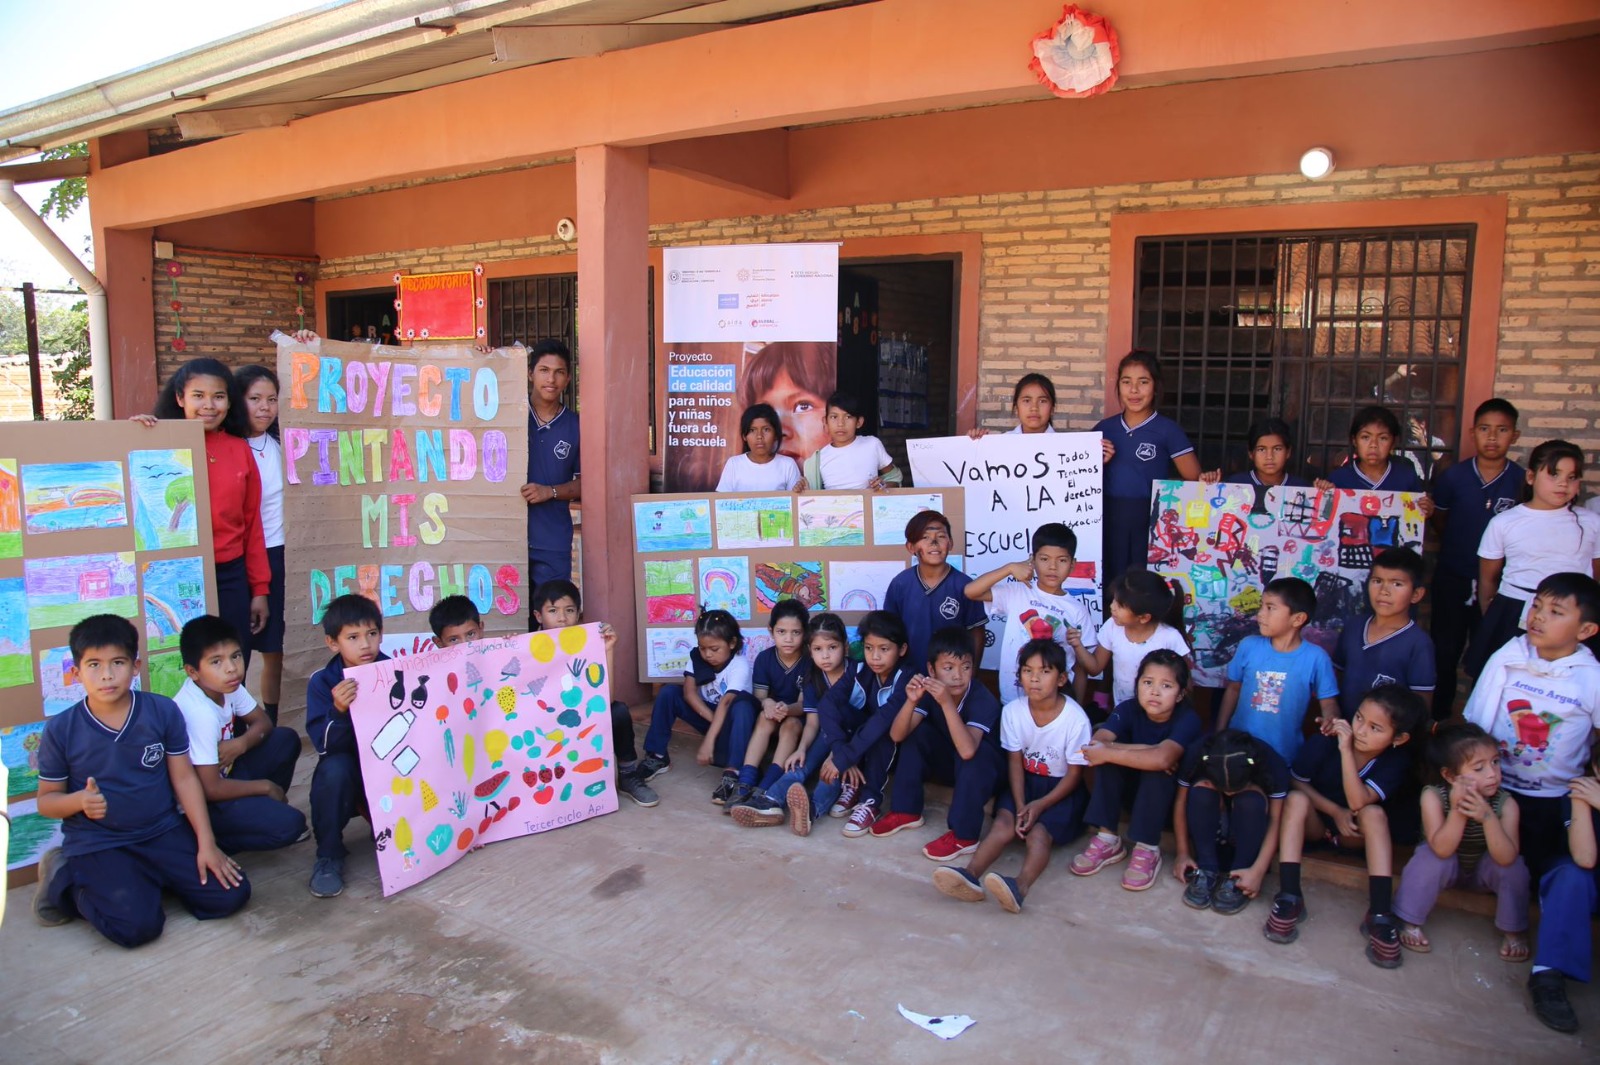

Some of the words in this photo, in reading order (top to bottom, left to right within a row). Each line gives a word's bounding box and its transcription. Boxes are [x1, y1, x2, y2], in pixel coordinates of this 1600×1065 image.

[669, 352, 713, 363] Proyecto
[671, 365, 733, 378] Educación
[290, 353, 499, 422] PROYECTO
[671, 380, 687, 391] de
[690, 380, 732, 391] calidad
[669, 397, 695, 408] para
[698, 395, 732, 407] niños
[669, 411, 676, 421] y
[679, 409, 712, 420] niñas
[668, 422, 699, 433] fuera
[702, 422, 718, 433] de
[669, 435, 679, 446] la
[682, 436, 727, 447] escuela
[284, 428, 508, 486] PINTANDO
[1058, 451, 1090, 465] Todos
[991, 489, 1008, 512] A
[1026, 485, 1056, 512] LA
[1064, 486, 1102, 502] derecho
[361, 492, 449, 548] MIS
[310, 561, 521, 625] DERECHOS
[1512, 680, 1544, 695] Arturo
[524, 819, 554, 833] Tercer
